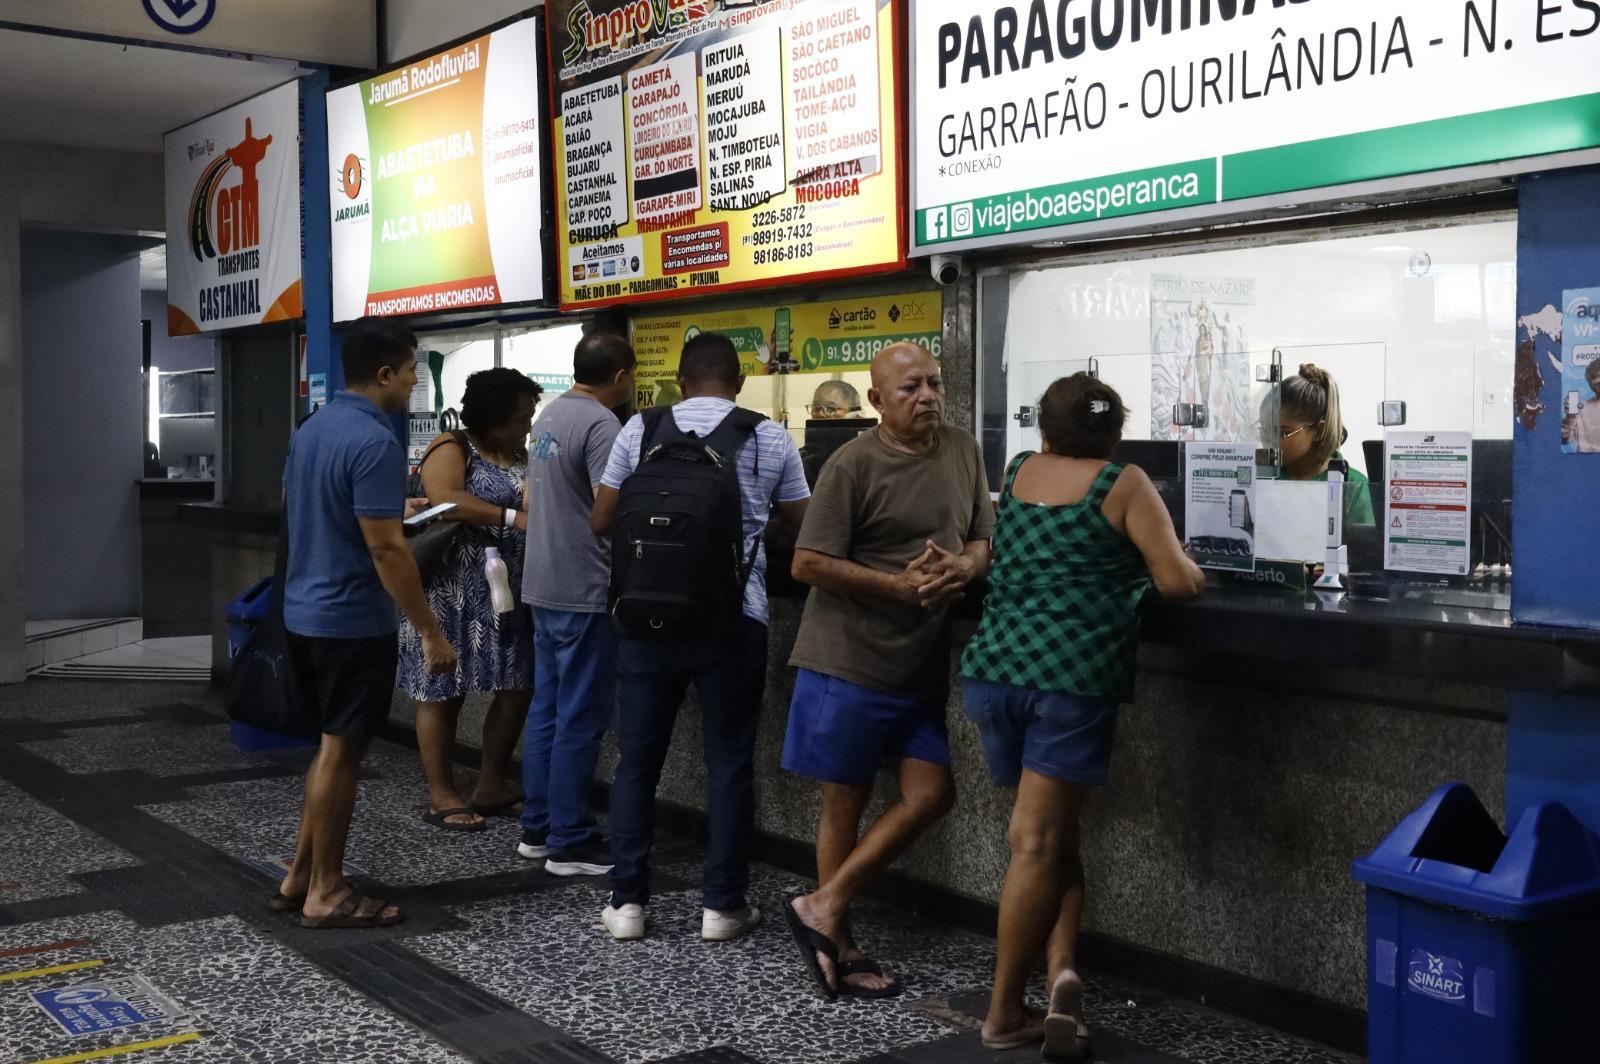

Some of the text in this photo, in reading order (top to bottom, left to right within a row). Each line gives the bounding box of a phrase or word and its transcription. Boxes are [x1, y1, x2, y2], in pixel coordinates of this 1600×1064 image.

[791, 6, 860, 40] SÃO MIGUEL
[705, 43, 744, 68] IRITUIA
[792, 25, 871, 61] SÃO CAETANO
[368, 43, 480, 105] Jarumã Rodofluvial
[631, 64, 672, 90] CAMETÁ
[706, 59, 750, 87] MARUDÁ
[938, 75, 1107, 158] GARRAFÃO
[1141, 16, 1413, 118] OURILÂNDIA
[1463, 0, 1513, 57] N.
[564, 83, 619, 111] ABAETETUBA
[631, 81, 680, 109] CARAPAJÓ
[707, 82, 744, 107] MERUÚ
[794, 74, 857, 103] TAILÂNDIA
[565, 106, 593, 128] ACARÁ
[633, 102, 688, 128] CONCÓRDIA
[707, 99, 766, 127] MOCAJUBA
[795, 93, 856, 119] TOMÉ-AÇU
[565, 128, 591, 146] BAIÃO
[708, 123, 738, 143] MOJU
[795, 121, 828, 140] VIGIA
[377, 130, 475, 180] ABAETETUBA
[566, 140, 612, 163] BRAGANÇA
[634, 135, 693, 161] CURUÇAMBABA
[709, 133, 780, 162] N. TIMBOTEUA
[796, 128, 878, 160] V. DOS CABANOS
[567, 159, 600, 178] BUJARU
[635, 153, 694, 179] GAR. DO NORTE
[709, 151, 772, 180] N. ESP. PIRIÁ
[834, 159, 862, 178] ALTA
[412, 176, 437, 198] VIA
[567, 172, 617, 194] CASTANHAL
[710, 175, 754, 197] SALINAS
[795, 178, 860, 205] MOCOOCA
[335, 199, 370, 222] JARUMÃ
[568, 190, 611, 209] CAPANEMA
[636, 191, 696, 215] IGARAPÉ-MIRI
[710, 191, 771, 213] SANT. NOVO
[975, 172, 1199, 233] viajeboaesperanca
[216, 179, 260, 255] CTM
[380, 201, 474, 243] ALÇA VIÁRIA
[568, 205, 612, 226] CAP. POÇO
[636, 208, 696, 234] MARAPANIM
[568, 220, 619, 245] CURUÇÁ
[667, 228, 721, 245] Transportamos
[582, 243, 625, 259] Aceitamos
[668, 240, 722, 256] Encomendas p/
[686, 252, 728, 266] localidades
[217, 249, 260, 277] TRANSPORTES
[574, 270, 720, 301] MÃE DO RIO PARAGOMINAS IPIXUNA
[1191, 279, 1207, 295] DE
[199, 278, 261, 322] CASTANHAL
[367, 285, 495, 316] TRANSPORTAMOS ENCOMENDAS
[843, 301, 928, 322] cartão pix
[1576, 303, 1600, 322] aq
[827, 346, 840, 360] 91.
[637, 391, 654, 406] PIX
[1225, 454, 1253, 462] WHATSAPP
[1414, 970, 1463, 994] SINART
